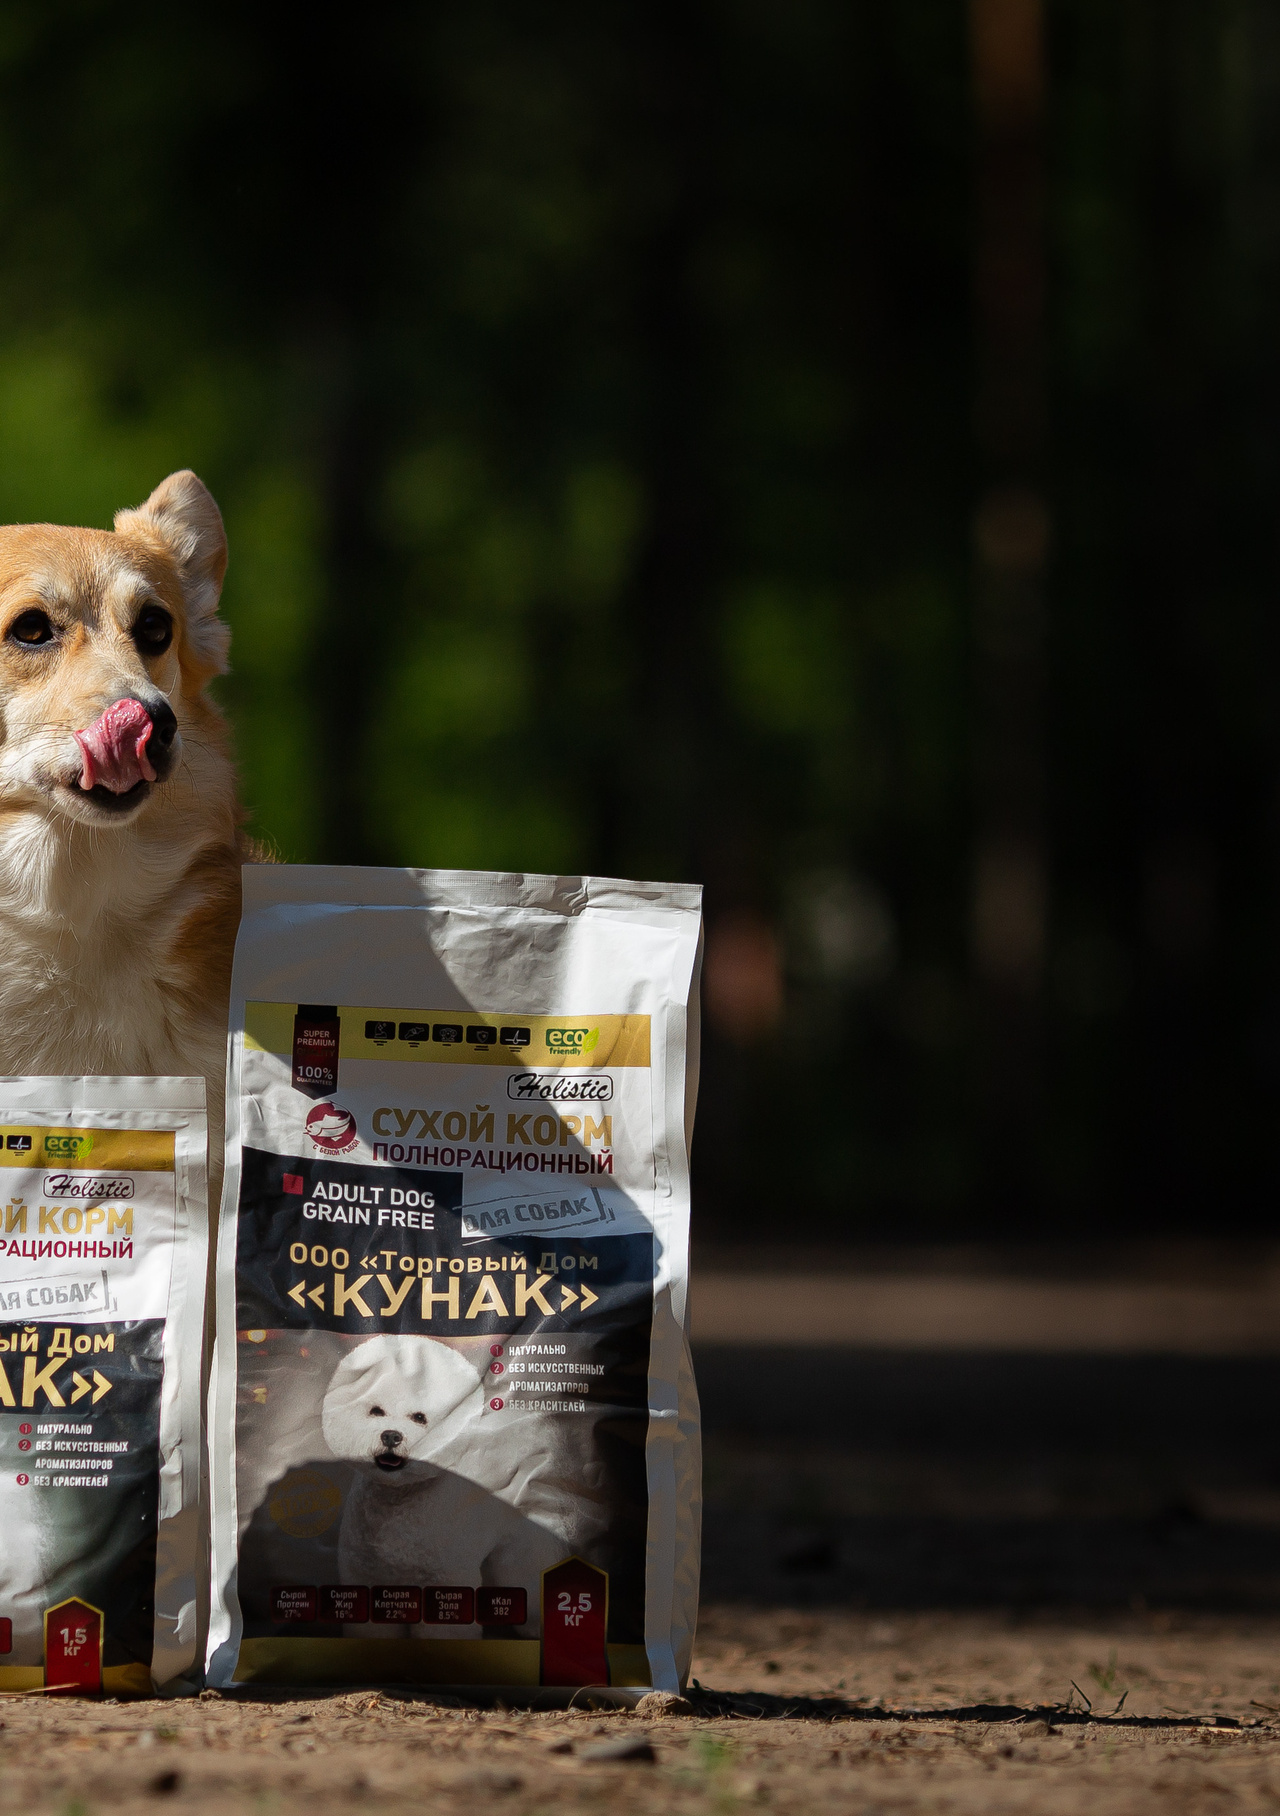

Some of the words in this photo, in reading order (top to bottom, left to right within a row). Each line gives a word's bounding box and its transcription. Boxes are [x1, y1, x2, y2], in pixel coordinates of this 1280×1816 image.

[303, 1030, 330, 1038] SUPER
[549, 1031, 583, 1045] eco
[296, 1038, 335, 1046] PREMIUM
[549, 1047, 581, 1055] friendly
[297, 1065, 333, 1079] 100%
[296, 1077, 333, 1085] GUARANTEED
[514, 1073, 609, 1100] Holistic
[372, 1104, 495, 1143] СУХОЙ
[507, 1113, 613, 1147] КОРМ
[47, 1138, 82, 1149] eco
[320, 1148, 340, 1156] БЕЛОЙ
[342, 1139, 360, 1154] РЫБОЙ
[47, 1151, 77, 1160] friendly
[372, 1142, 613, 1175] ПОЛНОРАЦИОННЫЙ
[48, 1174, 131, 1198] Holistic
[312, 1181, 384, 1204] ADULT
[390, 1188, 435, 1209] DOG
[514, 1196, 592, 1221] СОБАК
[38, 1206, 133, 1235] КОРМ
[303, 1202, 370, 1226] GRAIN
[377, 1209, 435, 1230] FREE
[289, 1242, 350, 1270] ООО
[359, 1250, 527, 1278] «Торговый
[536, 1252, 598, 1275] Дом
[26, 1282, 98, 1307] СОБАК
[287, 1273, 599, 1320] «КУНАК»
[48, 1327, 115, 1358] Дом
[508, 1344, 566, 1356] НАТУРАЛЬНО
[508, 1363, 525, 1373] БЕЗ
[528, 1363, 604, 1375] ИСКУССТВЕННЫХ
[509, 1381, 589, 1393] АРОМАТИЗАТОРОВ
[509, 1400, 525, 1409] БЕЗ
[528, 1399, 586, 1412] КРАСИТЕЛЕЙ
[37, 1424, 93, 1434] НАТУРАЛЬНО
[35, 1441, 52, 1451] БЕЗ
[54, 1441, 129, 1452] ИСКУССТВЕННЫХ
[35, 1458, 113, 1470] АРОМАТИЗАТОРОВ
[34, 1476, 50, 1486] БЕЗ
[52, 1475, 108, 1487] КРАСИТЕЛЕЙ
[280, 1590, 306, 1600] Сырой
[330, 1590, 358, 1601] Сырой
[382, 1590, 410, 1600] Сырая
[435, 1591, 463, 1601] Сырая
[276, 1600, 310, 1610] Протеин
[334, 1600, 353, 1610] Жир
[374, 1600, 418, 1609] Клетчатка
[438, 1601, 459, 1610] Зола
[491, 1597, 512, 1606] кКал
[557, 1591, 592, 1614] 2,5
[284, 1610, 301, 1618] 27%
[334, 1610, 353, 1619] 16%
[493, 1607, 510, 1616] 382
[60, 1628, 87, 1647] 1,5
